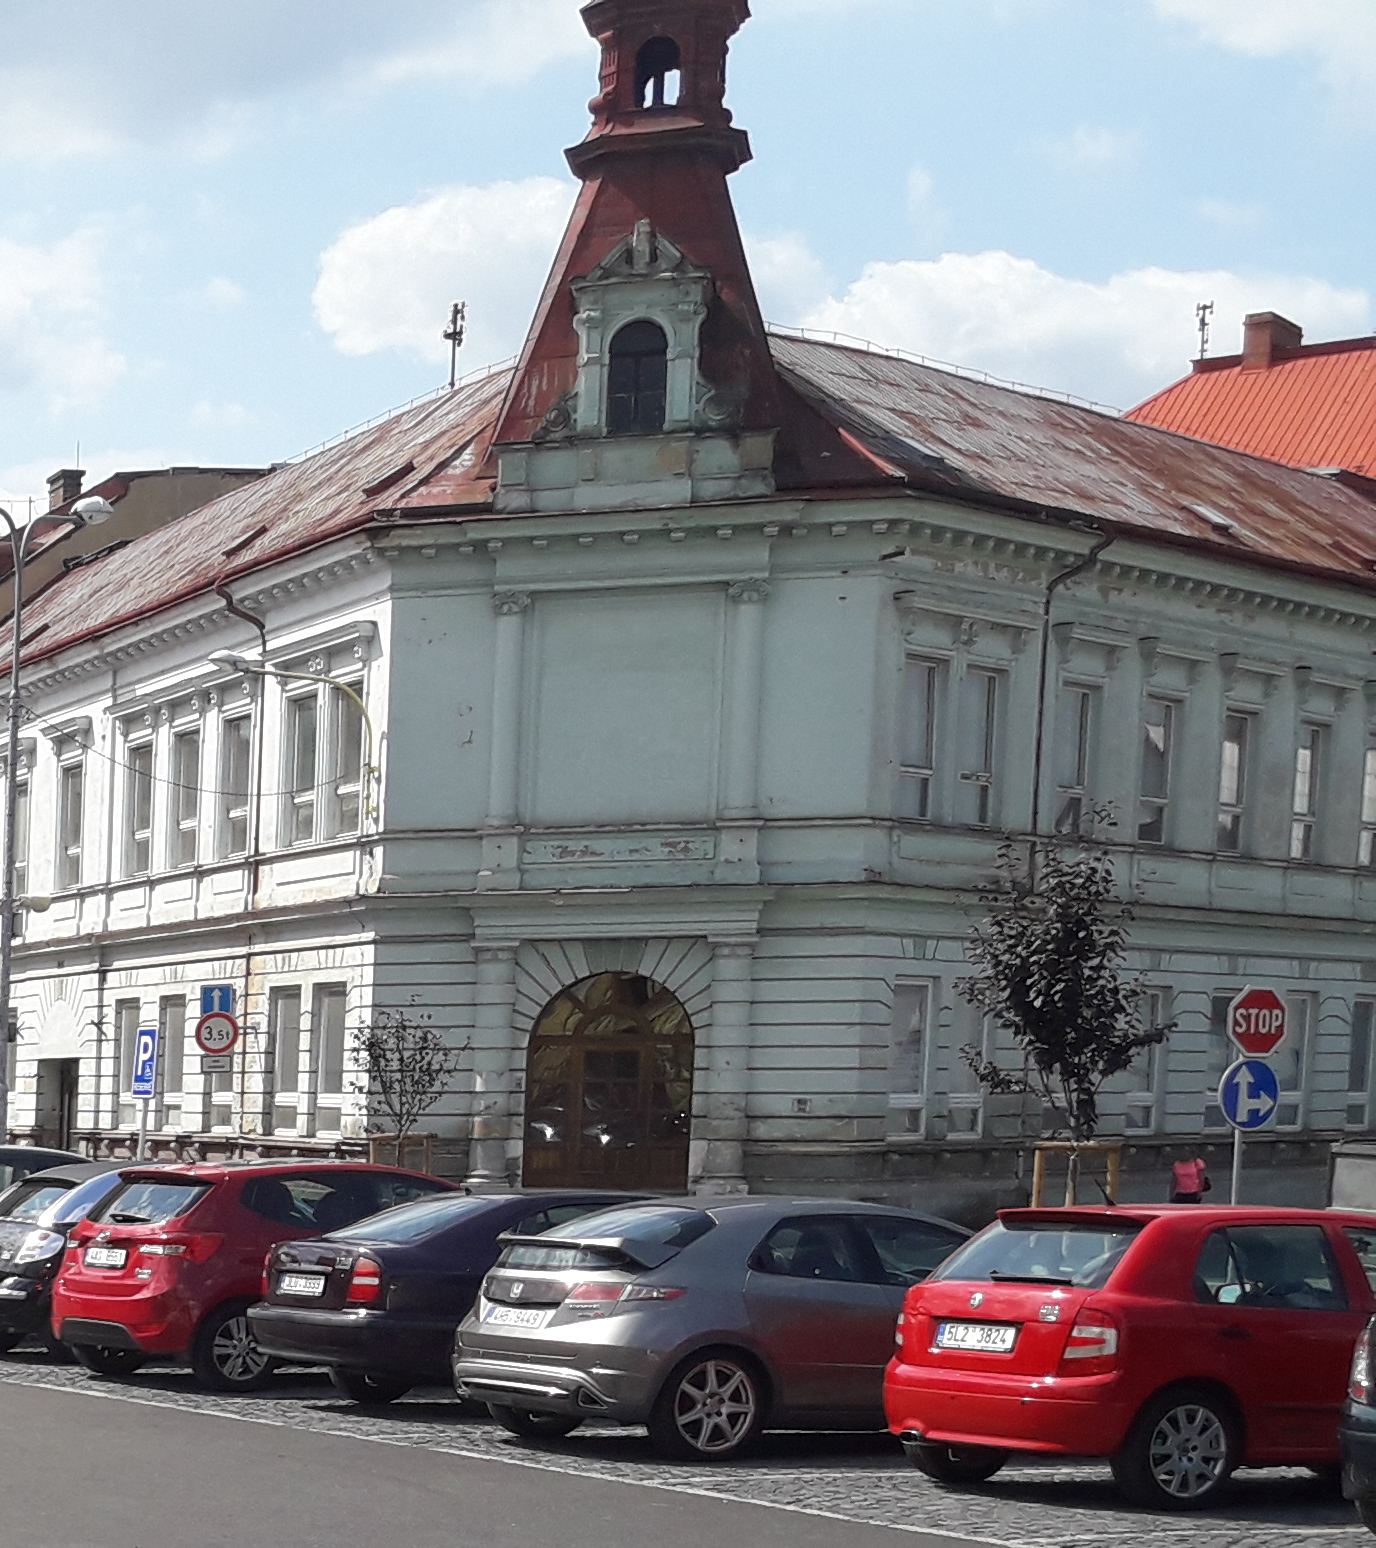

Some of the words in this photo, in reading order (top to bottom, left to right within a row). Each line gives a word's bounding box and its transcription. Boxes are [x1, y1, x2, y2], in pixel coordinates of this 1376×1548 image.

[1234, 1007, 1283, 1034] STOP
[137, 1035, 153, 1076] P
[947, 1325, 969, 1343] 5L2
[976, 1327, 1008, 1345] 3824
